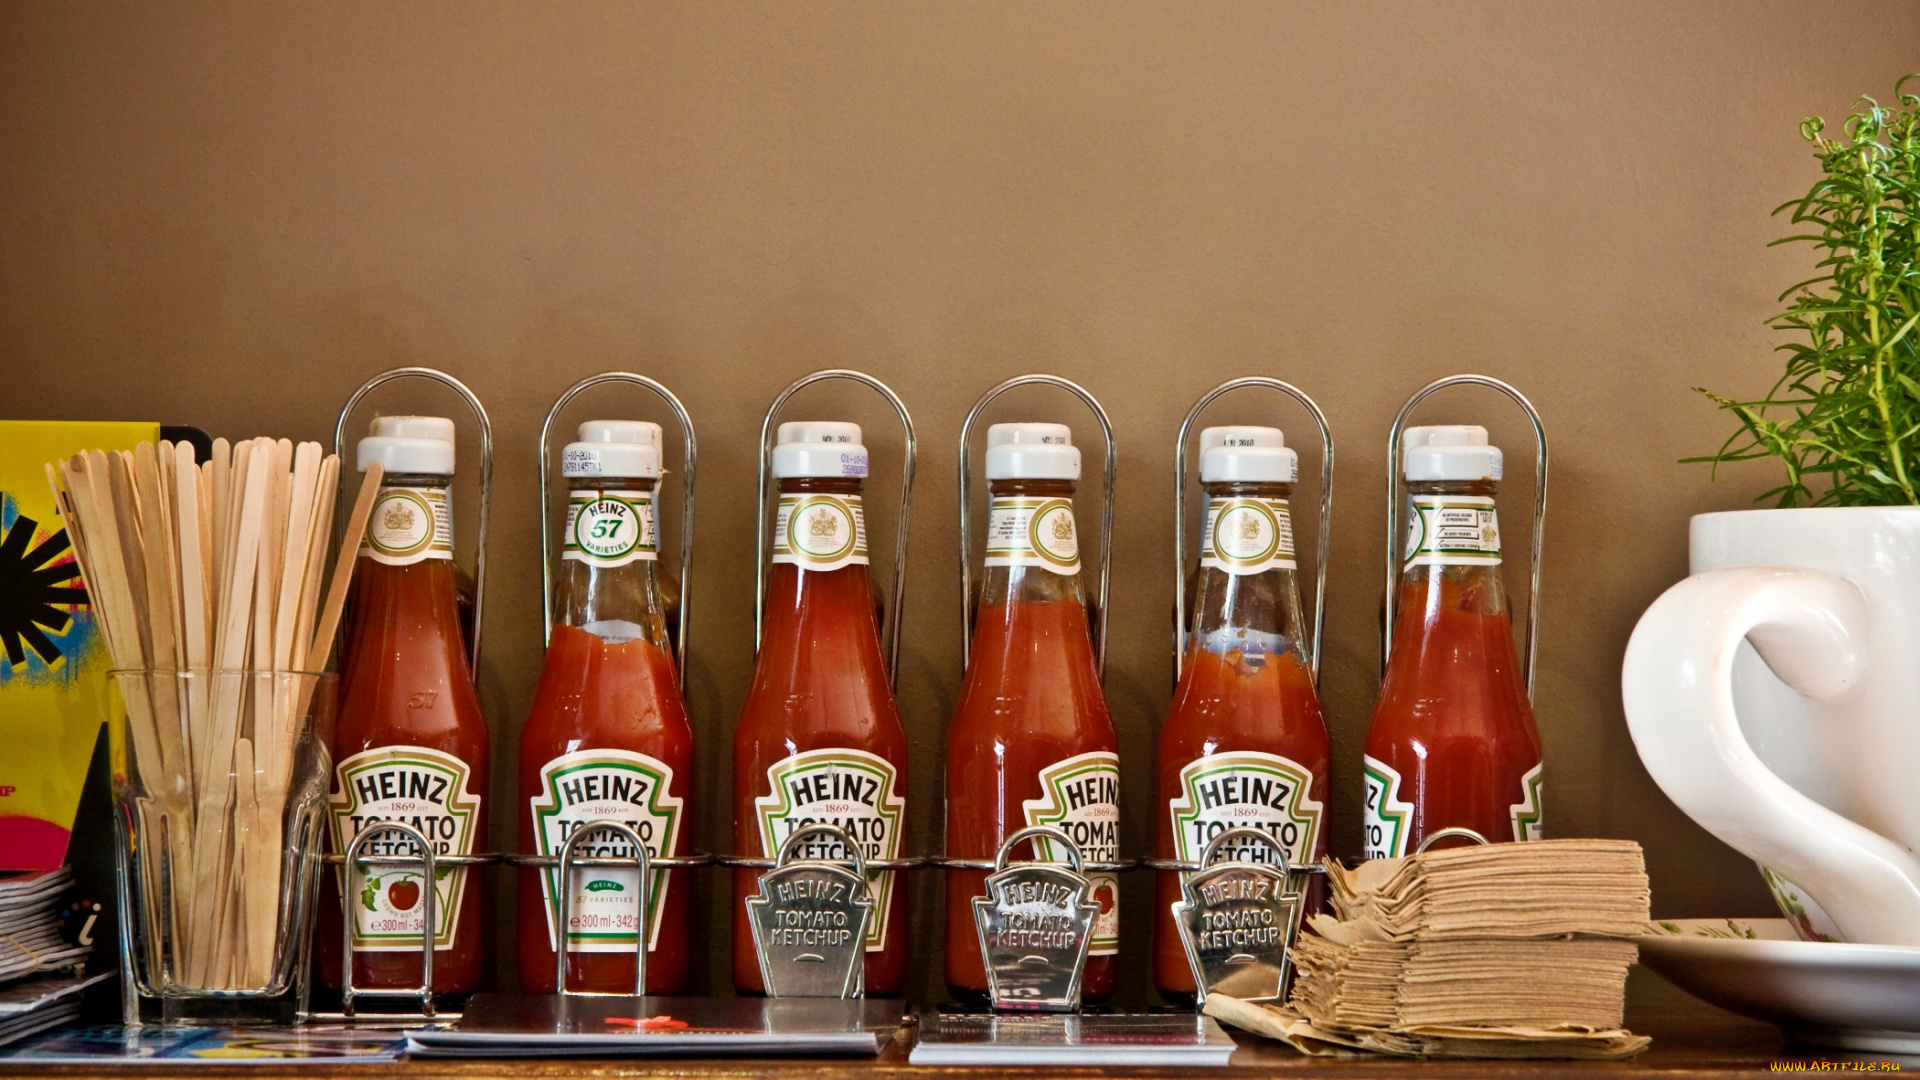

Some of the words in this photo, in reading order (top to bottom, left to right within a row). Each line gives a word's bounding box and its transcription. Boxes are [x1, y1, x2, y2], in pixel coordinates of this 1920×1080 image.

[589, 502, 626, 517] HEINZ
[591, 519, 623, 538] 57
[586, 540, 629, 553] VARIETIES
[356, 771, 448, 805] HEINZ
[562, 775, 648, 806] HEINZ
[790, 773, 878, 807] HEINZ
[1200, 776, 1290, 811] HEINZ
[391, 802, 416, 811] 1869
[594, 806, 617, 815] 1869
[825, 804, 850, 813] 1869
[1094, 807, 1110, 817] 1869
[1233, 808, 1258, 817] 1869
[1059, 821, 1119, 846] TOMAT
[777, 879, 846, 903] HEINZ
[1004, 881, 1073, 909] HEINZ
[1201, 880, 1270, 906] HEINZ
[775, 910, 848, 928] TOMATO
[1002, 912, 1074, 931] TOMATO
[1202, 909, 1274, 931] TOMATO
[771, 928, 851, 946] KETCHUP
[996, 928, 1077, 949] KETCHUP
[1199, 927, 1280, 949] KETCHUP
